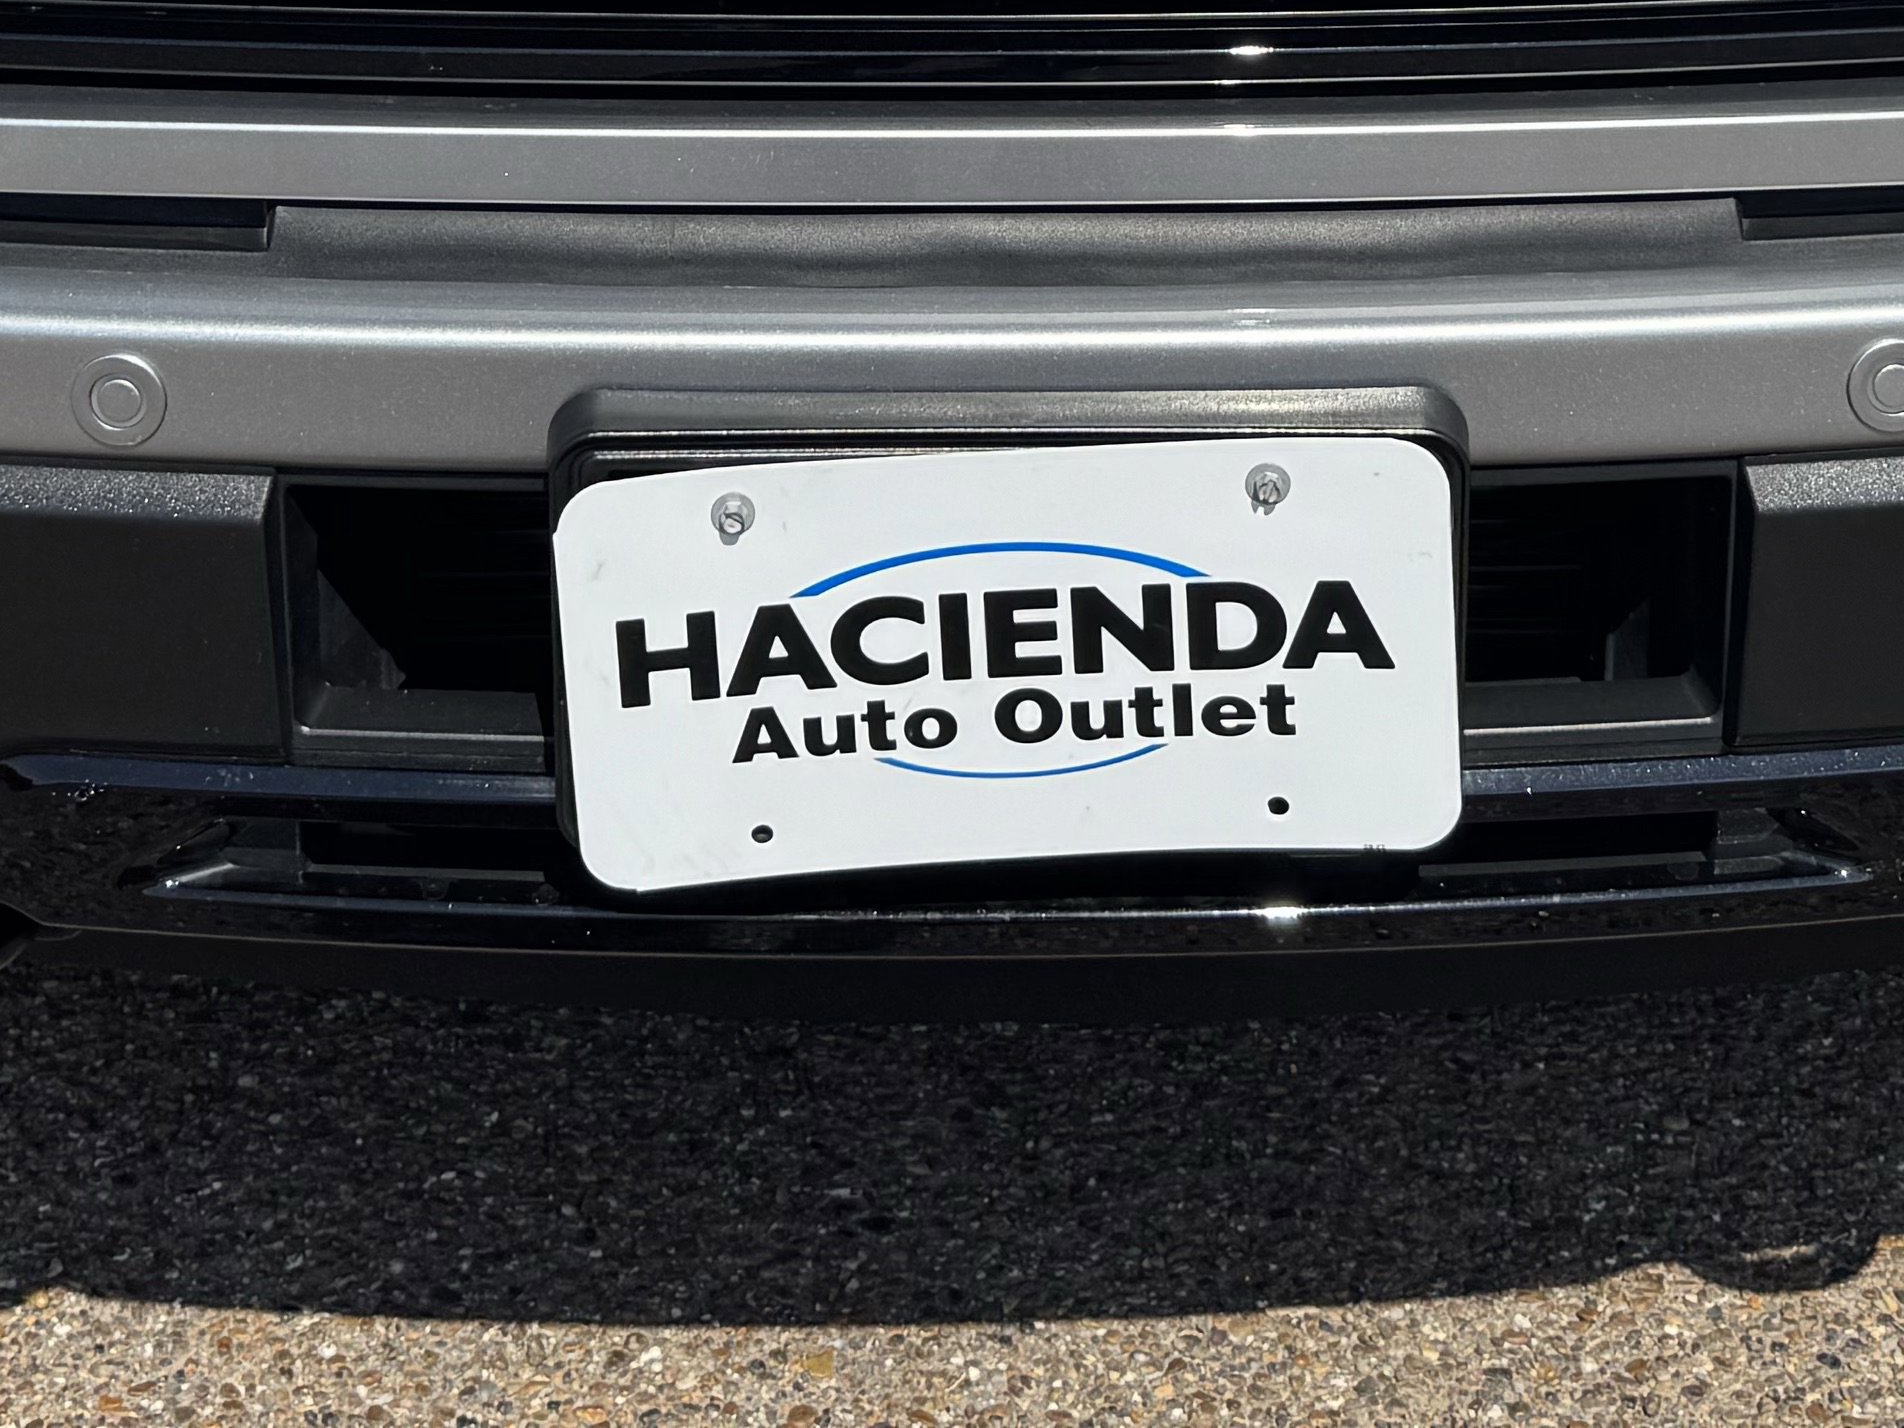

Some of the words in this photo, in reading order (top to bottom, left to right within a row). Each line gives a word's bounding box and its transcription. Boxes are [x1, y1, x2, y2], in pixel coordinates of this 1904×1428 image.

[615, 580, 1396, 709] HACIENDA
[732, 699, 958, 764] Auto
[994, 684, 1297, 744] Outlet
